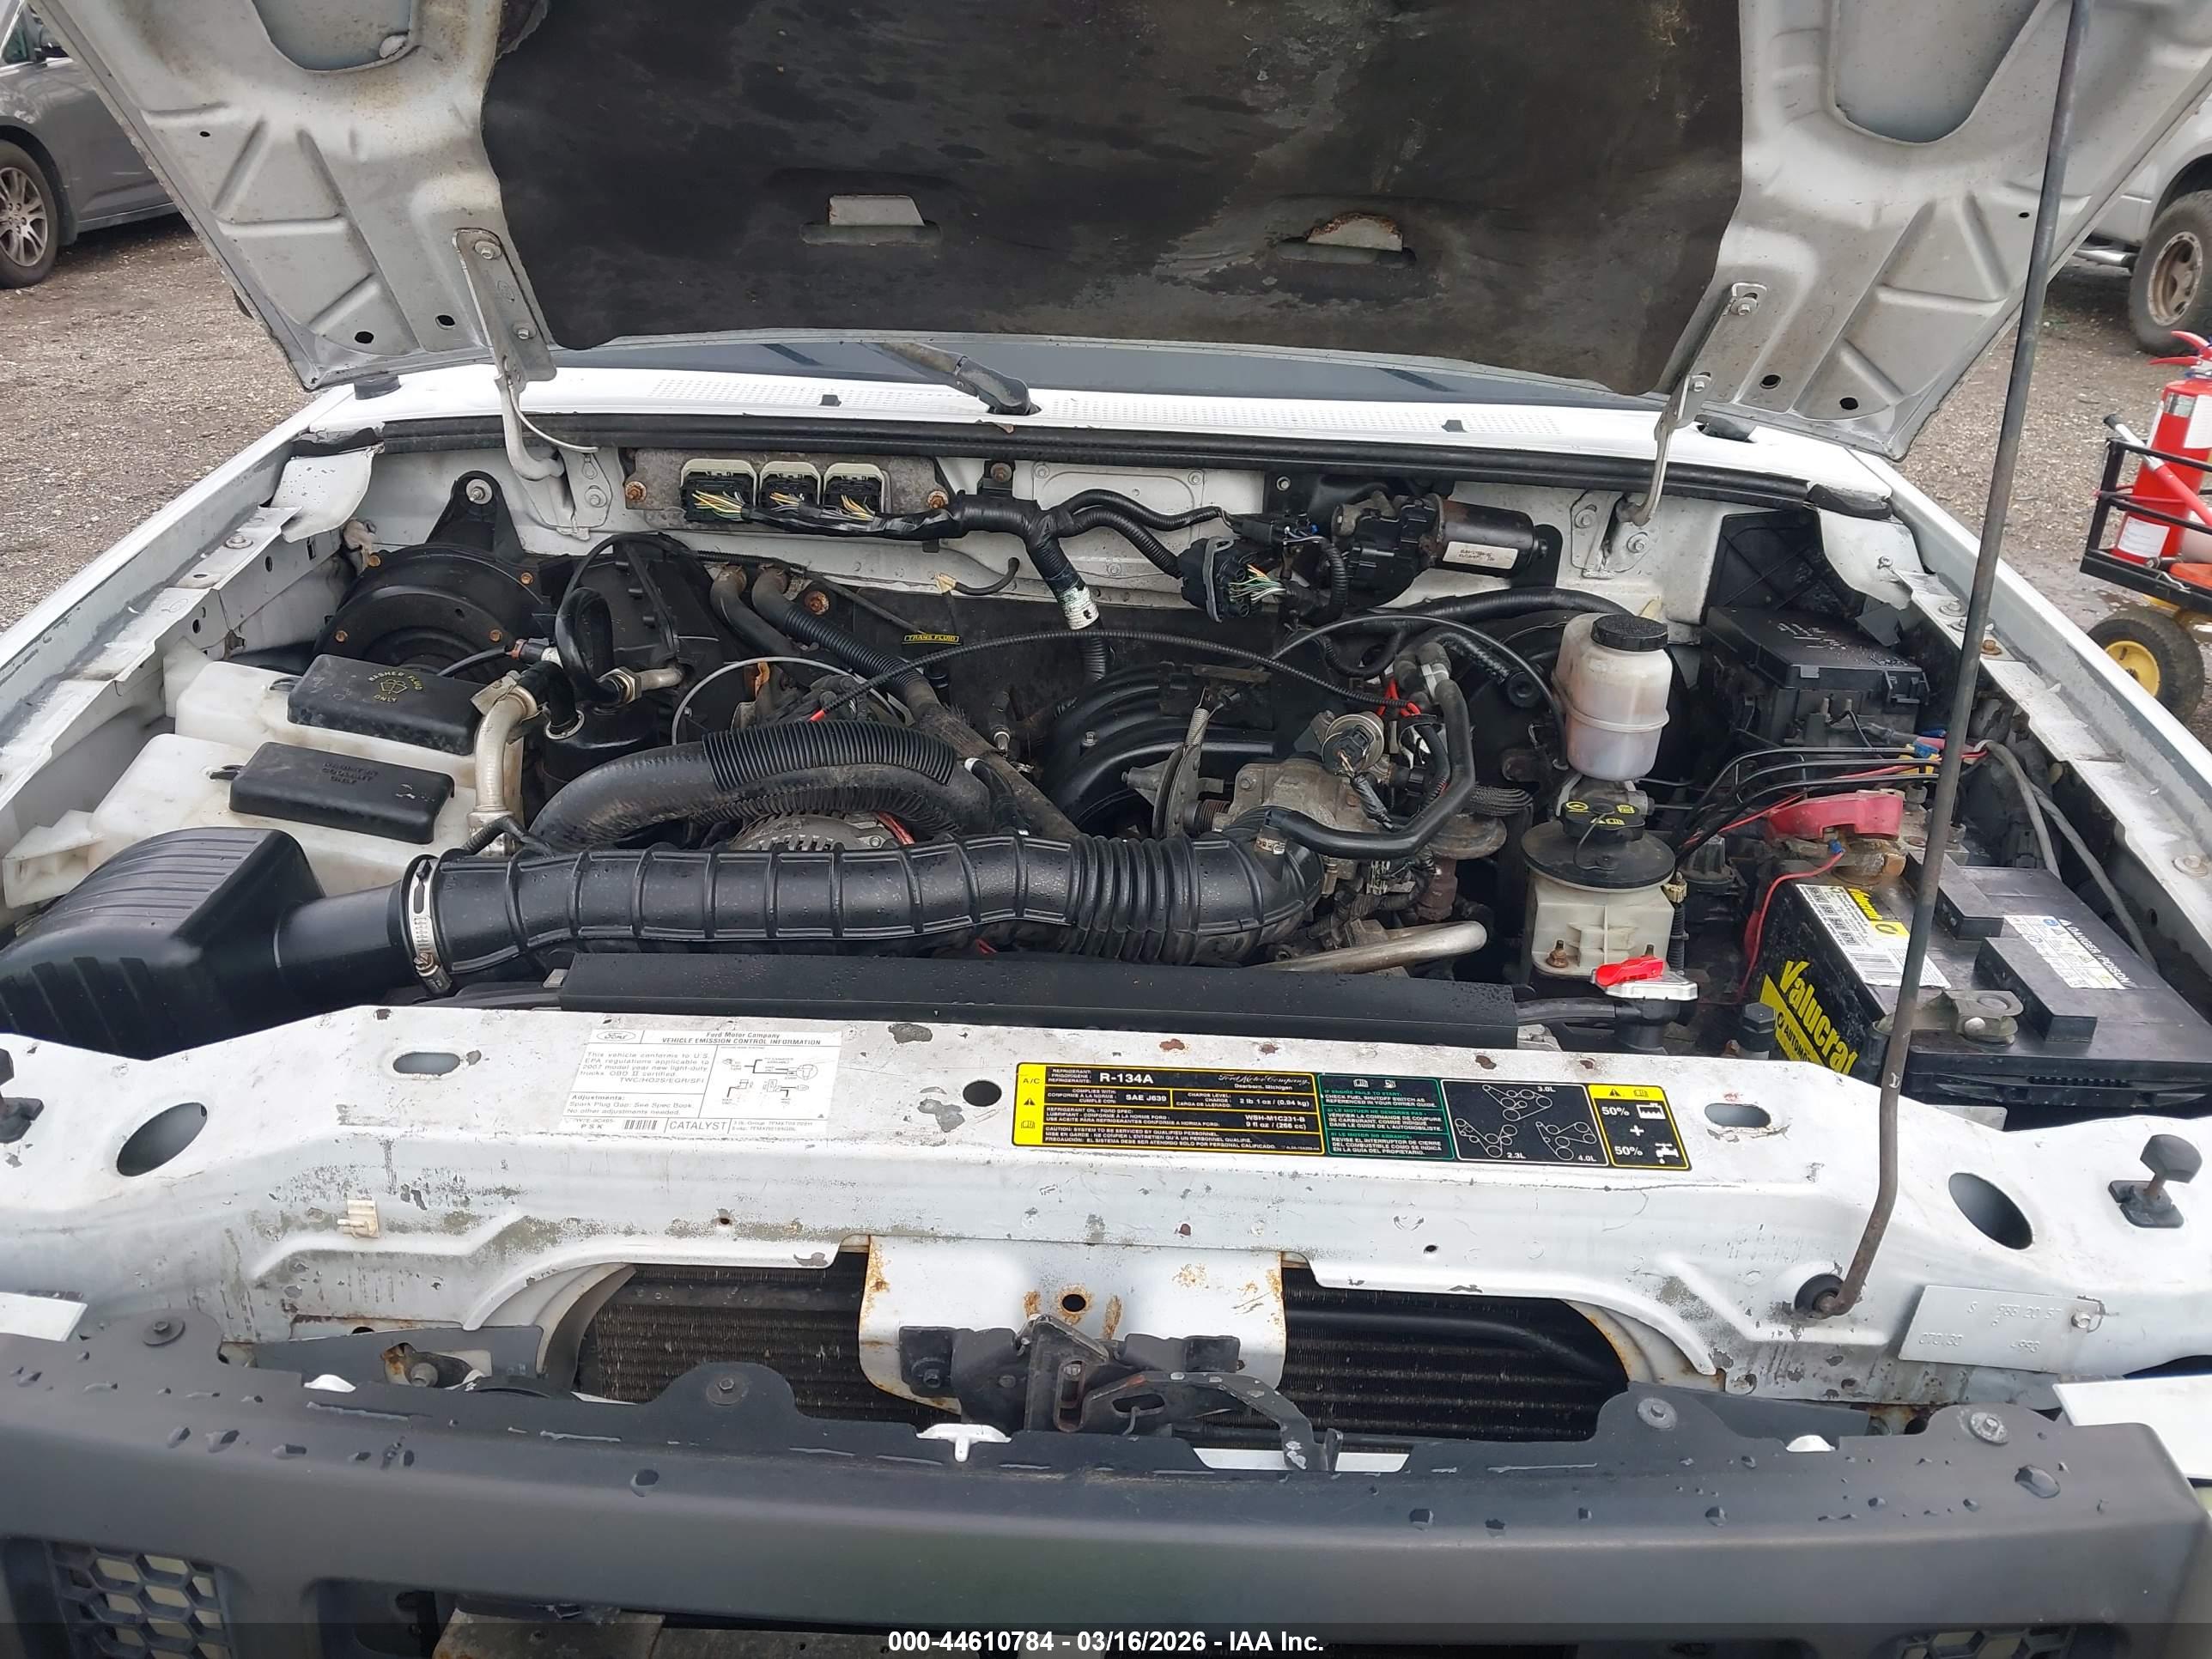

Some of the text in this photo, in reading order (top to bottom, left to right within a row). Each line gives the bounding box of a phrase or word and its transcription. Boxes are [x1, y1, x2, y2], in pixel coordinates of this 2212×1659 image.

[2067, 926, 2102, 954] DANGER
[1779, 960, 1858, 1075] Valucraf
[1784, 1024, 1808, 1061] AUTOMO
[1099, 1072, 1153, 1084] R-134A
[1237, 1075, 1266, 1083] Motor
[1601, 1106, 1630, 1116] 50%
[669, 1121, 728, 1130] CATALYST
[1630, 1124, 1644, 1136] +
[1614, 1146, 1643, 1156] 50%
